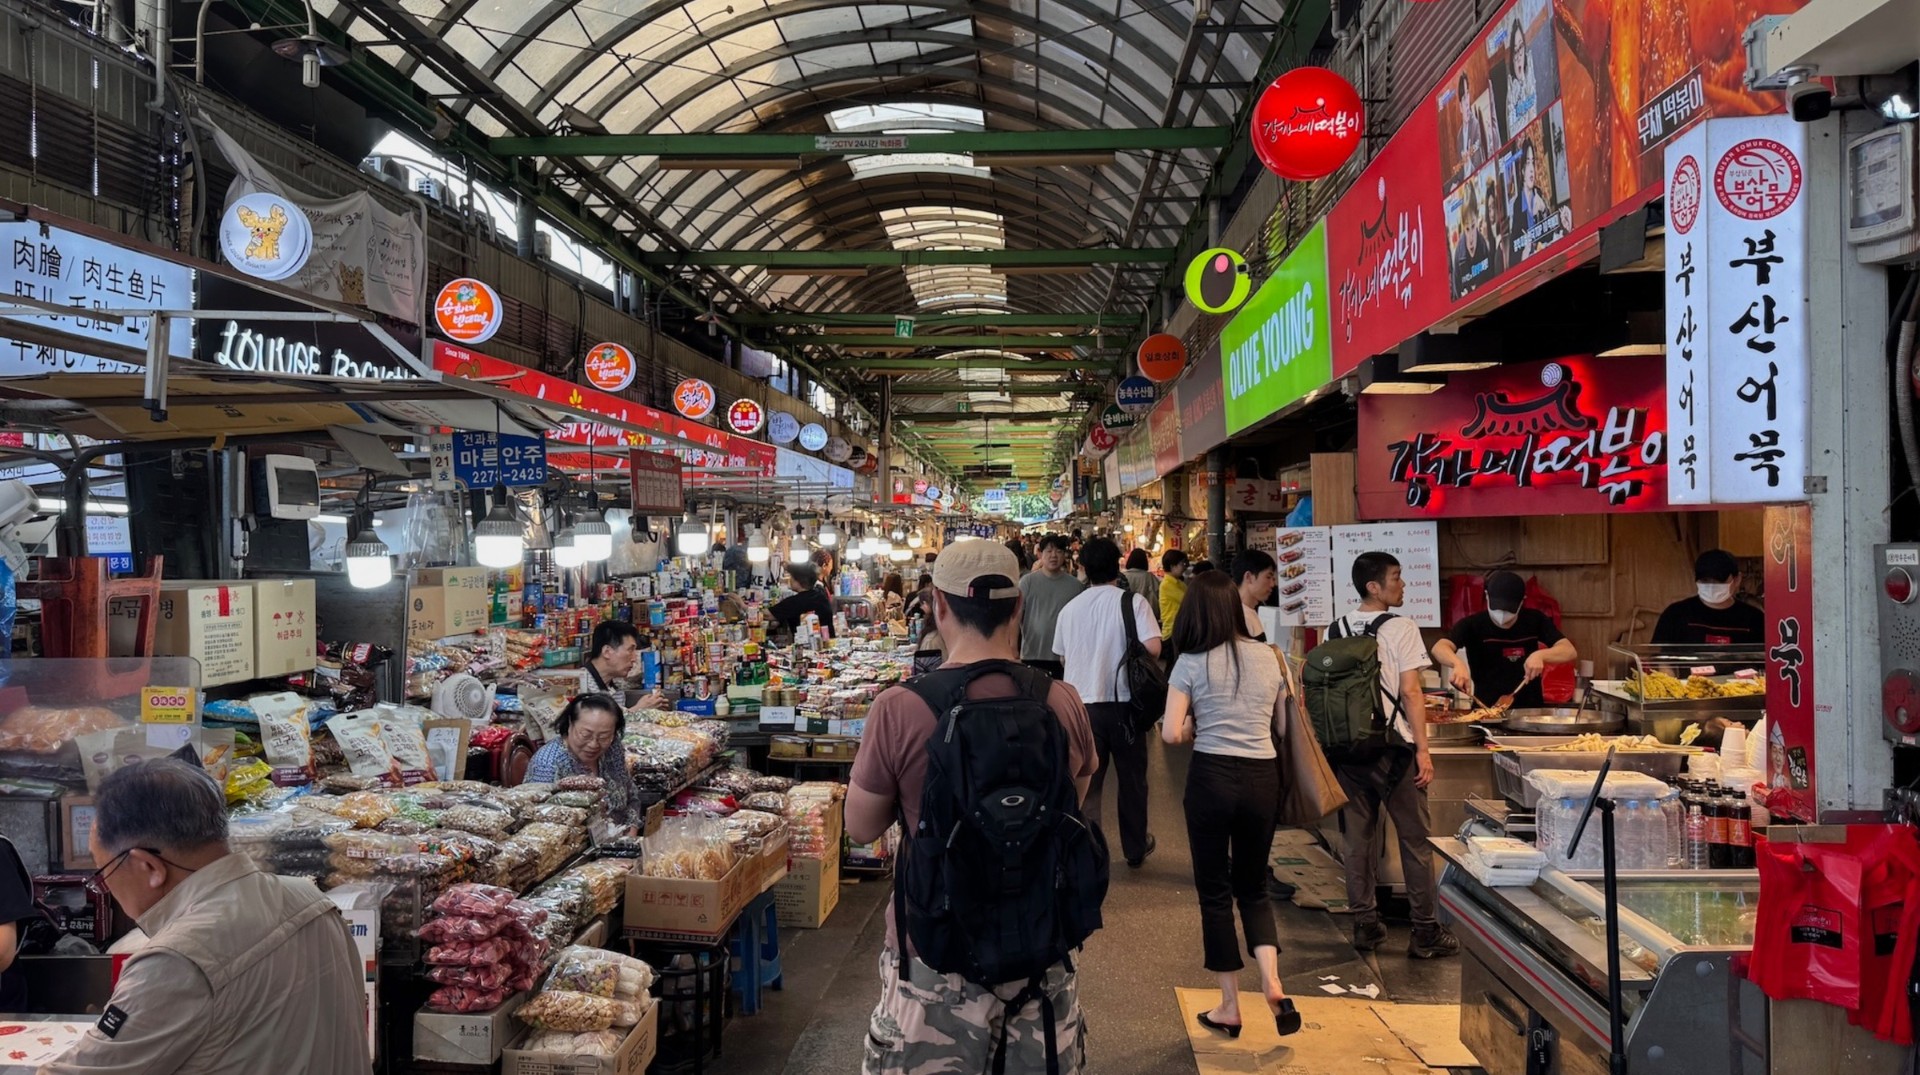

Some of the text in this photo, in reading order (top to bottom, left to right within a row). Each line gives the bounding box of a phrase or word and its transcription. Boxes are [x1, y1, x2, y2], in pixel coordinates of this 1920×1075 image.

[1638, 74, 1704, 146] 무채 떡볶이
[1718, 141, 1799, 176] BUSAN EOMUK CO-BRAND
[83, 256, 166, 306] 肉生鱼片
[1229, 281, 1313, 400] OLIVE YOUNG
[1676, 241, 1698, 490] 부산어묵
[1729, 228, 1789, 487] 부산어묵
[463, 433, 498, 447] 건과류
[435, 456, 450, 467] 21
[460, 445, 543, 468] 마른안주
[438, 472, 450, 481] 호
[472, 467, 543, 484] 2273-2425
[109, 601, 174, 619] 고급병
[276, 629, 302, 640] 취급주의
